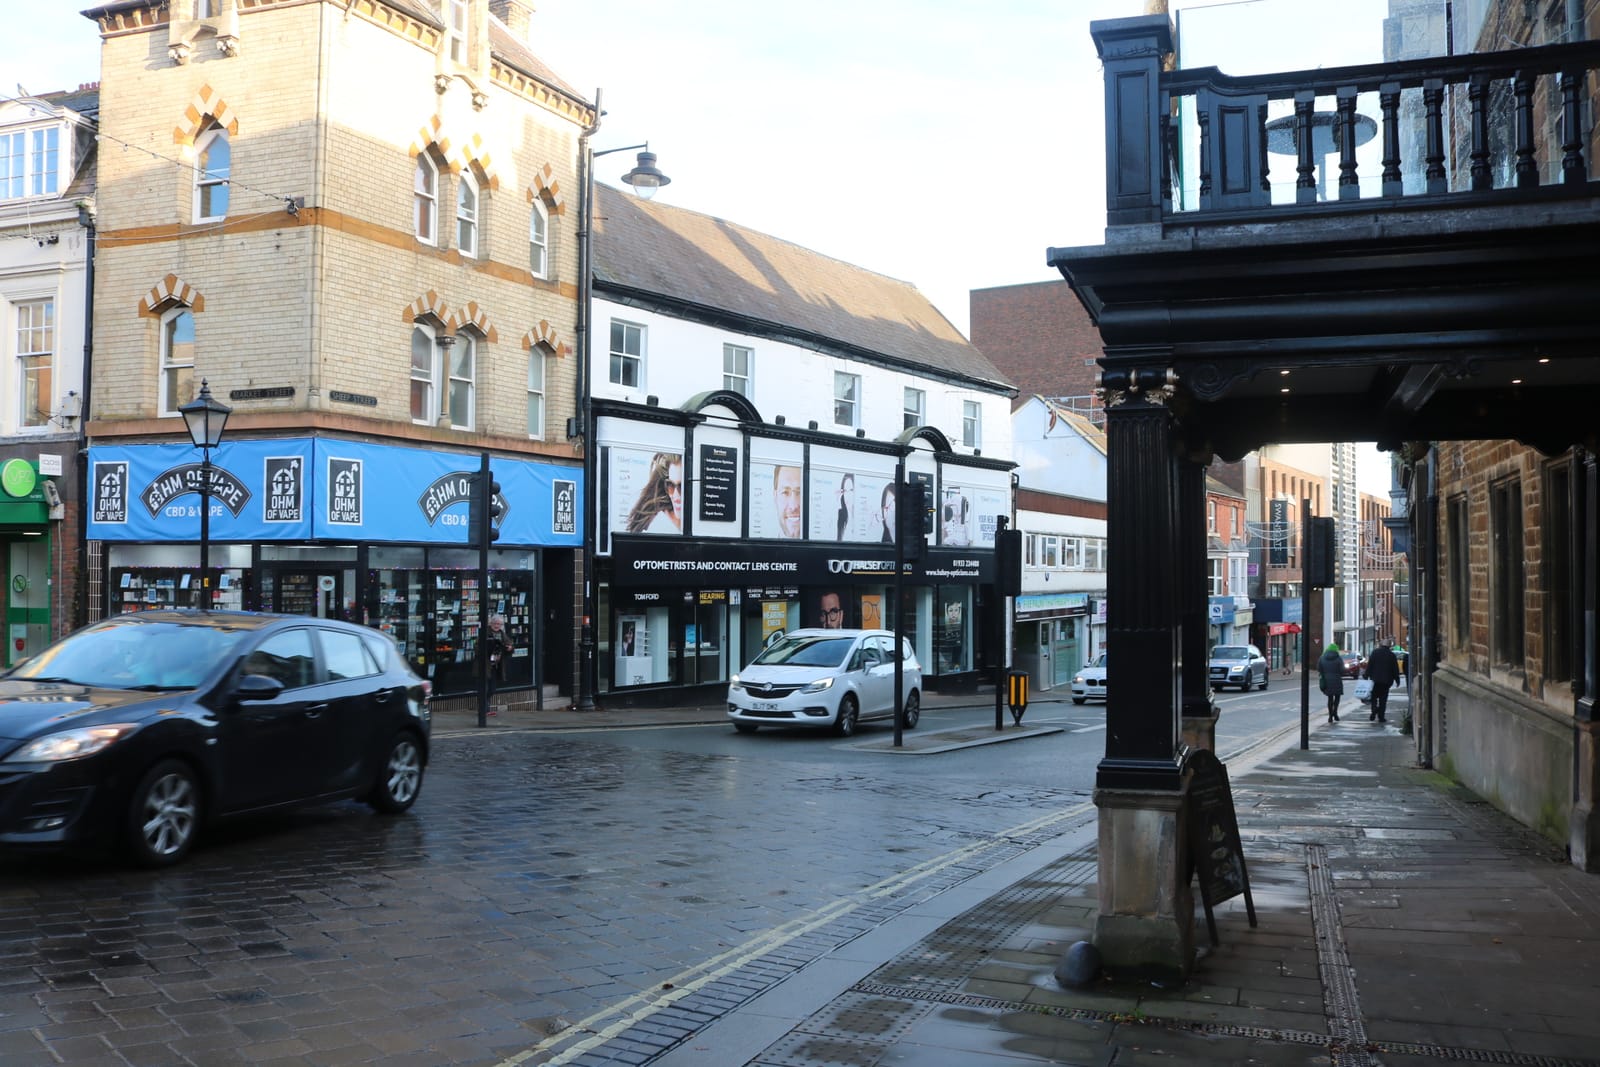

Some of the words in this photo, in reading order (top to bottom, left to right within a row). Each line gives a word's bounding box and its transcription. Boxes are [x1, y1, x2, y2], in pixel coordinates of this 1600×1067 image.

[266, 388, 292, 397] STREET
[352, 395, 376, 405] STREET
[209, 473, 243, 507] VAPE
[100, 499, 121, 510] OHM
[271, 496, 294, 509] OHM
[334, 498, 355, 511] OHM
[96, 511, 106, 521] OF
[107, 511, 124, 521] VAPE
[165, 506, 186, 517] CBD
[188, 506, 196, 517] &
[267, 509, 277, 519] OF
[279, 509, 299, 519] VAPE
[331, 511, 340, 521] OF
[342, 511, 359, 522] VAPE
[441, 514, 459, 526] CBD
[460, 515, 467, 526] &
[557, 511, 571, 524] OHM
[554, 523, 561, 531] OF
[562, 523, 574, 532] VAPE
[633, 560, 696, 570] OPTOMETRISTS
[697, 561, 714, 571] AND
[714, 561, 750, 571] CONTACT
[752, 562, 769, 571] LENS
[770, 562, 798, 571] CENTRE
[700, 591, 726, 600] HEARING
